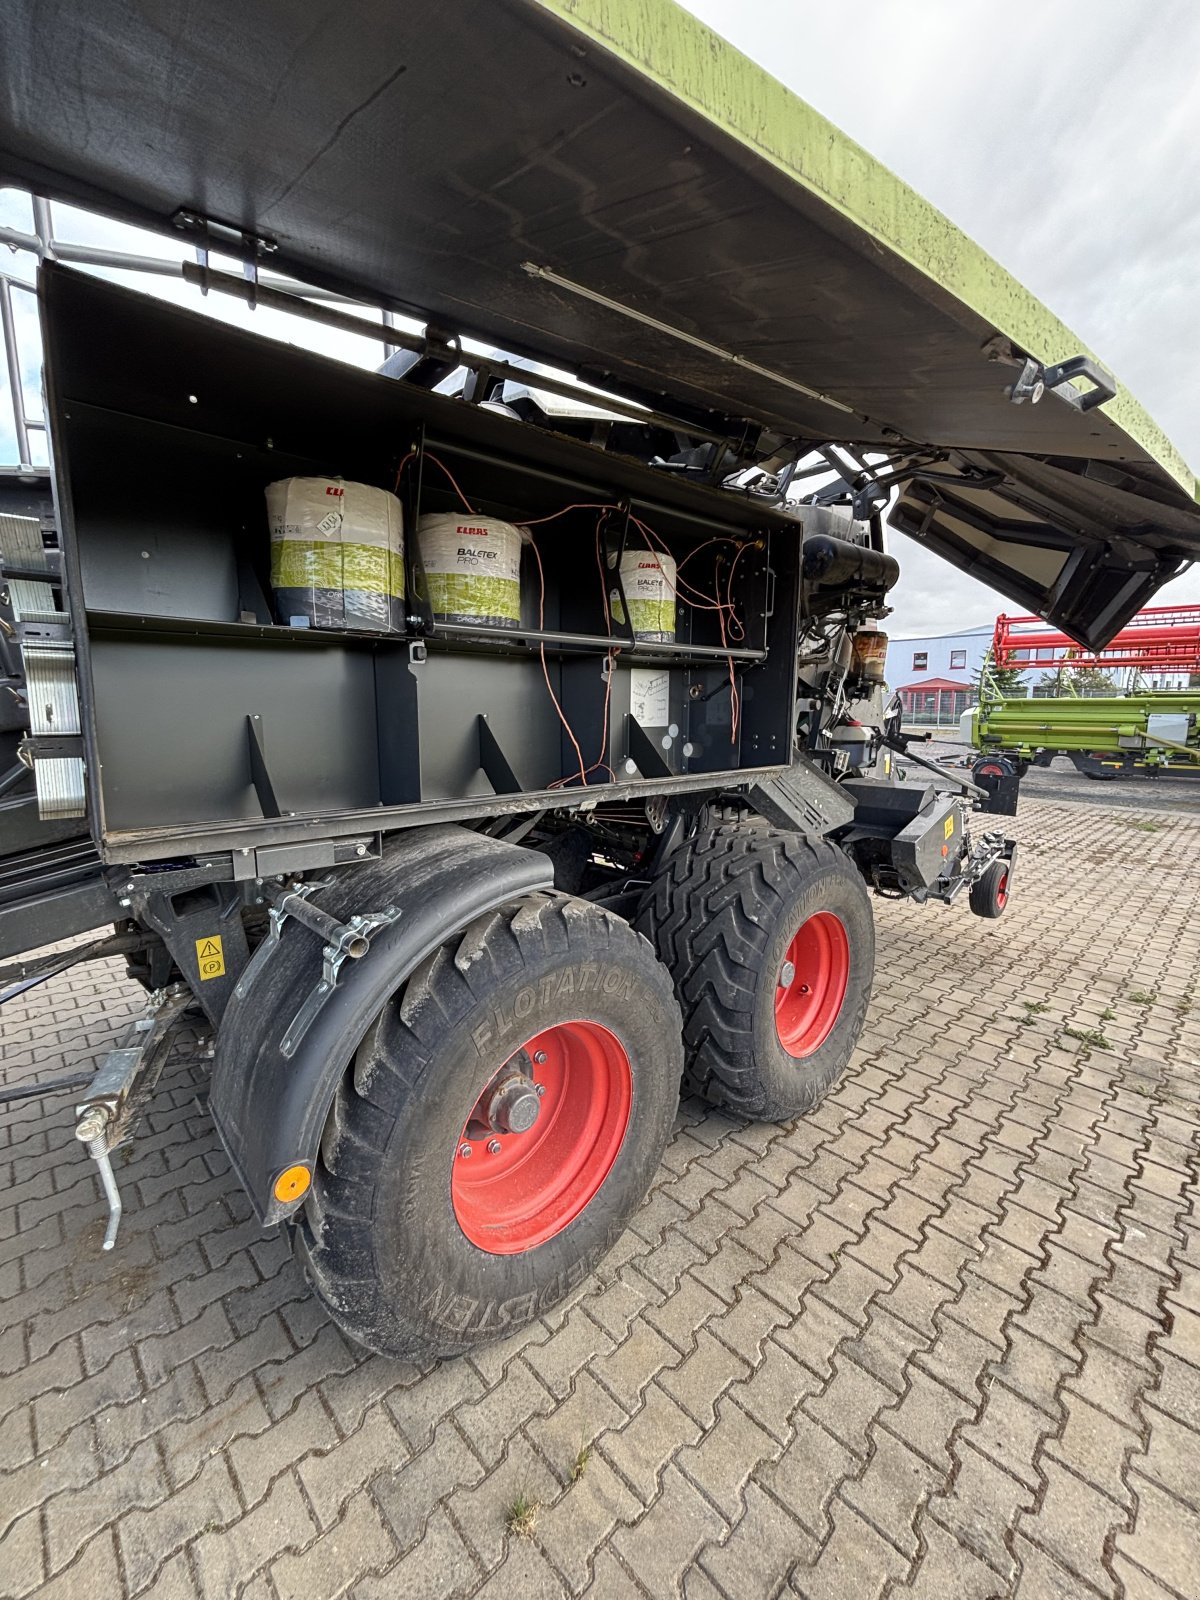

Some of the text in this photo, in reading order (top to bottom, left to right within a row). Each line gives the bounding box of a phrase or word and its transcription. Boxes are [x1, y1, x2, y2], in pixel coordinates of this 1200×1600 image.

[456, 526, 488, 536] CLAAS
[457, 547, 498, 560] BALETEX
[457, 556, 479, 566] PRO
[637, 562, 660, 570] CLAAS
[637, 579, 663, 587] BALETE
[471, 961, 641, 1058] FLOTATION
